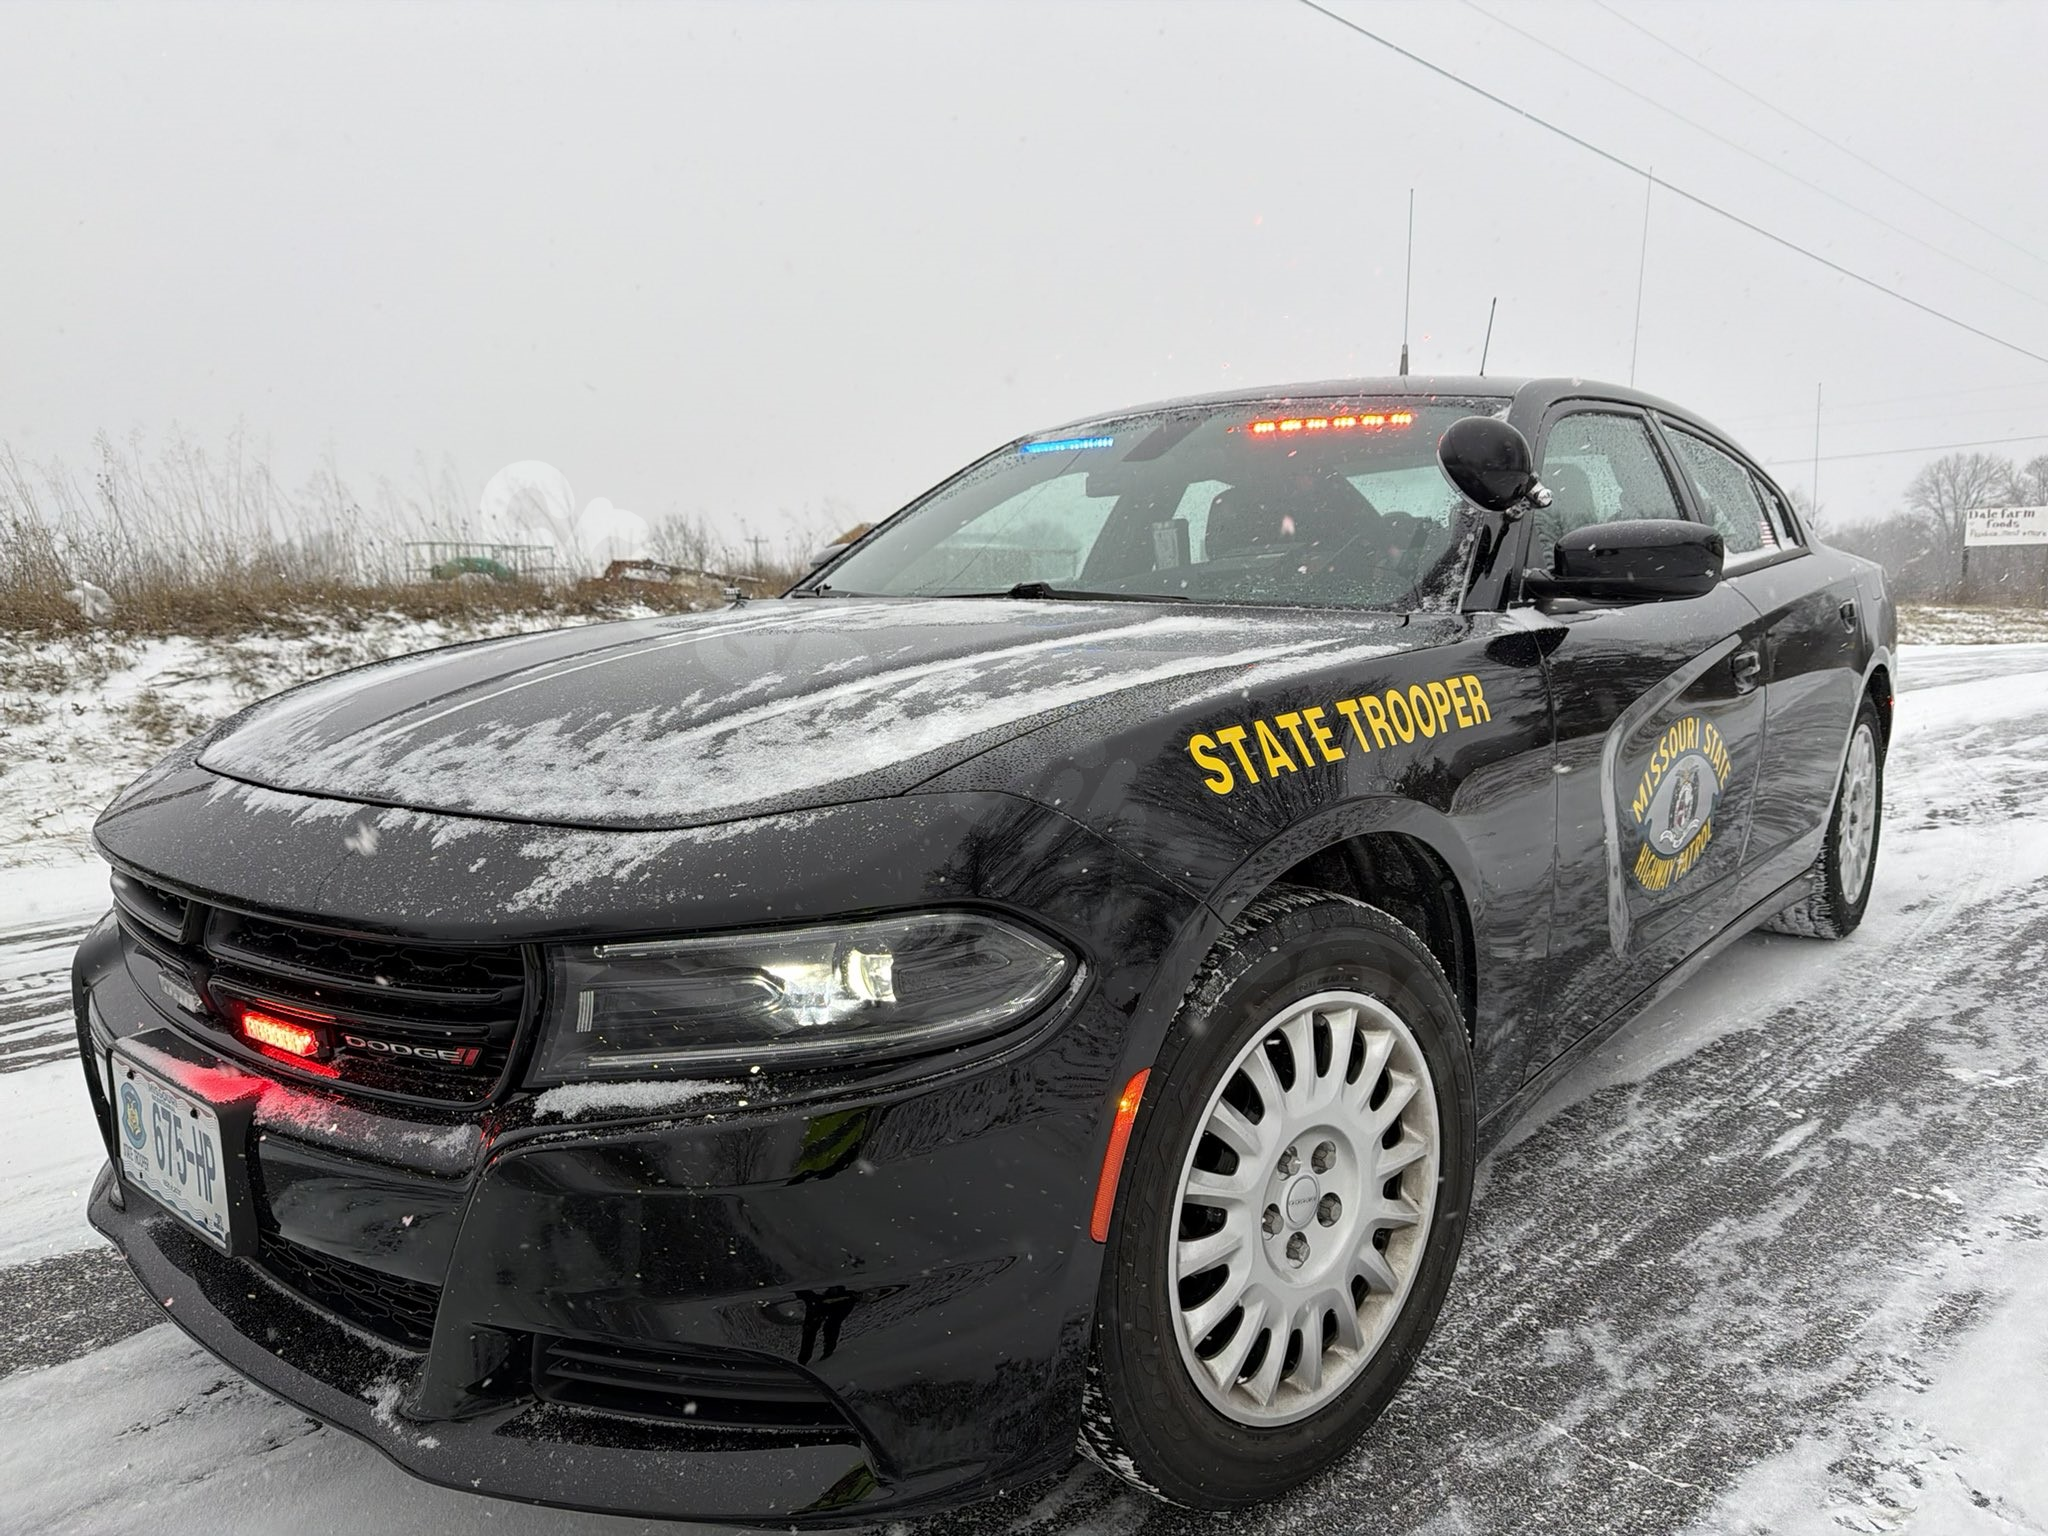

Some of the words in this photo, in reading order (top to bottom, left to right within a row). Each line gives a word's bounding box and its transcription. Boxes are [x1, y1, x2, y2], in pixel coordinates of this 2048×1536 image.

[1968, 508, 1998, 519] Dale
[1188, 705, 1346, 796] STATE
[1335, 673, 1493, 753] TROOPER
[1631, 715, 1701, 824] MISSOURI
[1702, 722, 1732, 789] STATE
[1633, 842, 1677, 892] HIGHWAY
[1674, 817, 1713, 882] PATROL
[346, 1034, 461, 1063] DODGE
[152, 1102, 216, 1205] 675-HP
